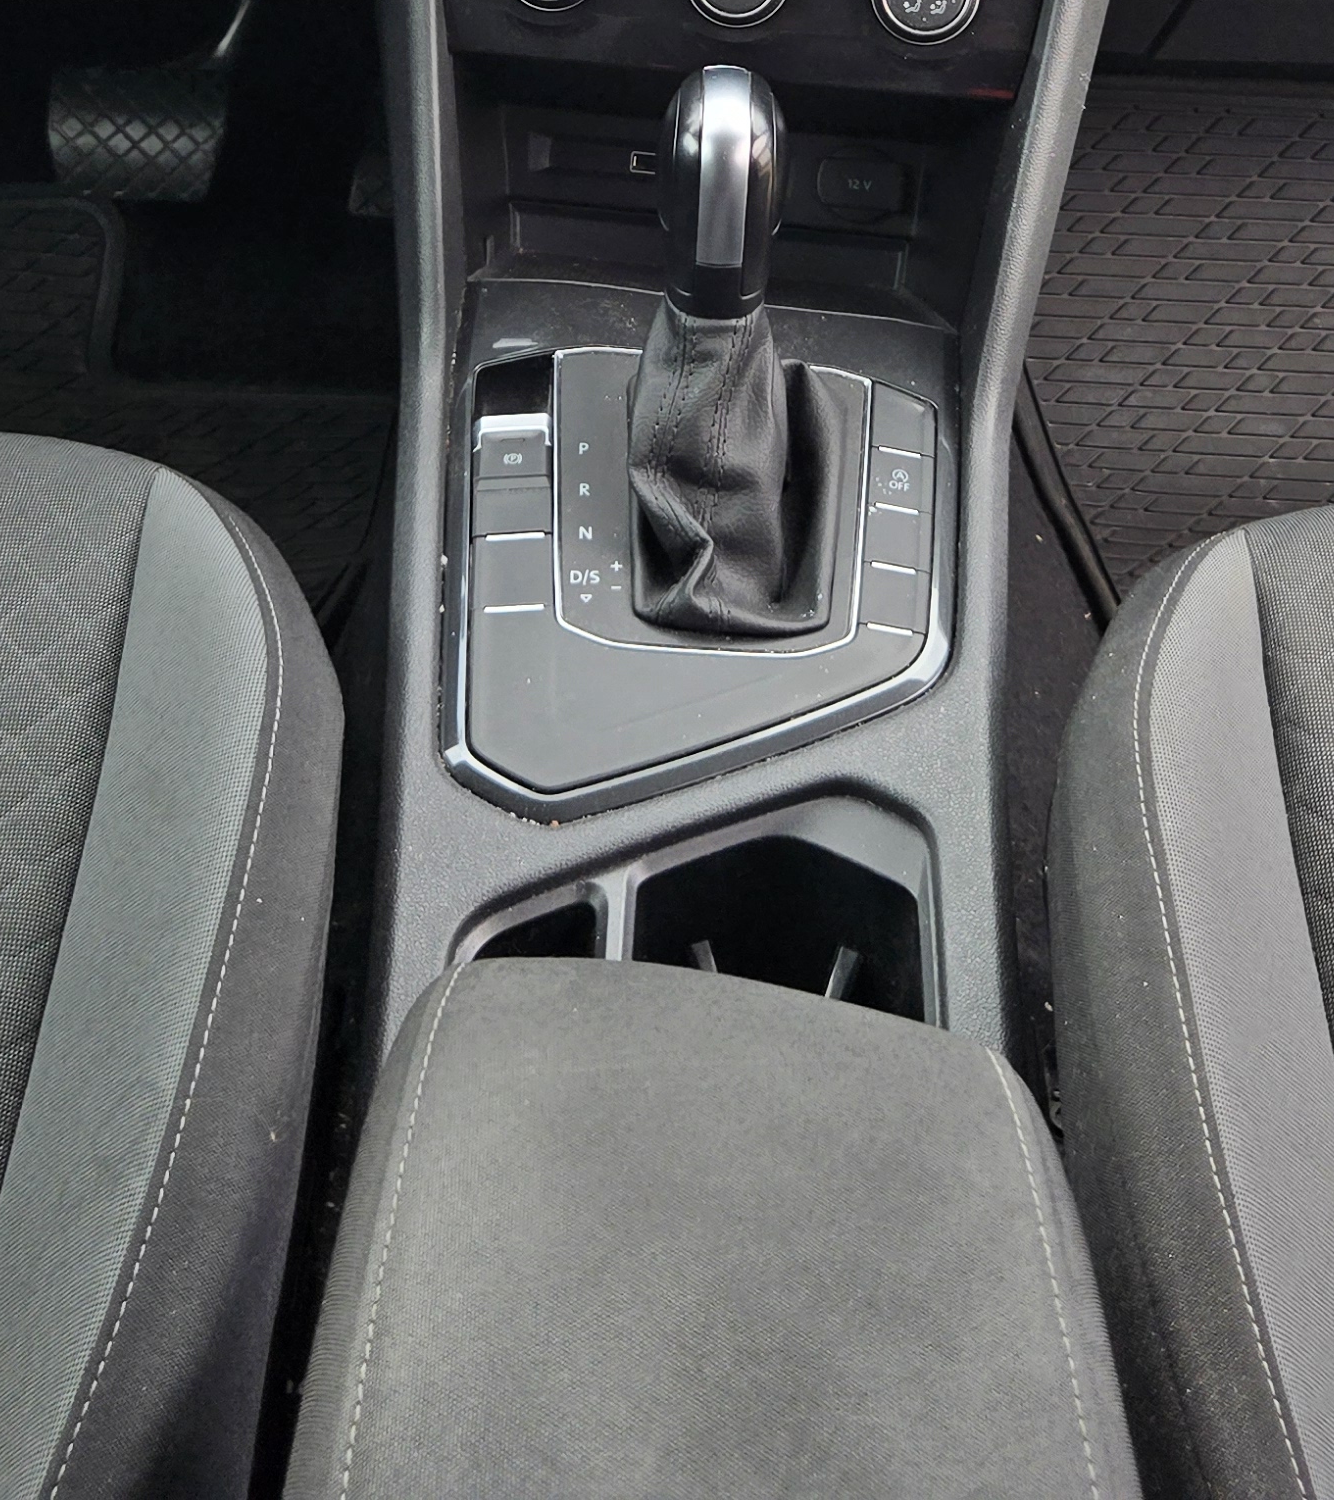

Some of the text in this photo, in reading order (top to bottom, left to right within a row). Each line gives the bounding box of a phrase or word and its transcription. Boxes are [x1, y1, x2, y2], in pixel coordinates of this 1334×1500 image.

[848, 178, 872, 192] 12 V
[578, 442, 590, 455] P
[579, 482, 591, 497] R
[888, 480, 910, 492] OFF
[578, 525, 593, 540] N
[569, 568, 601, 586] D/S
